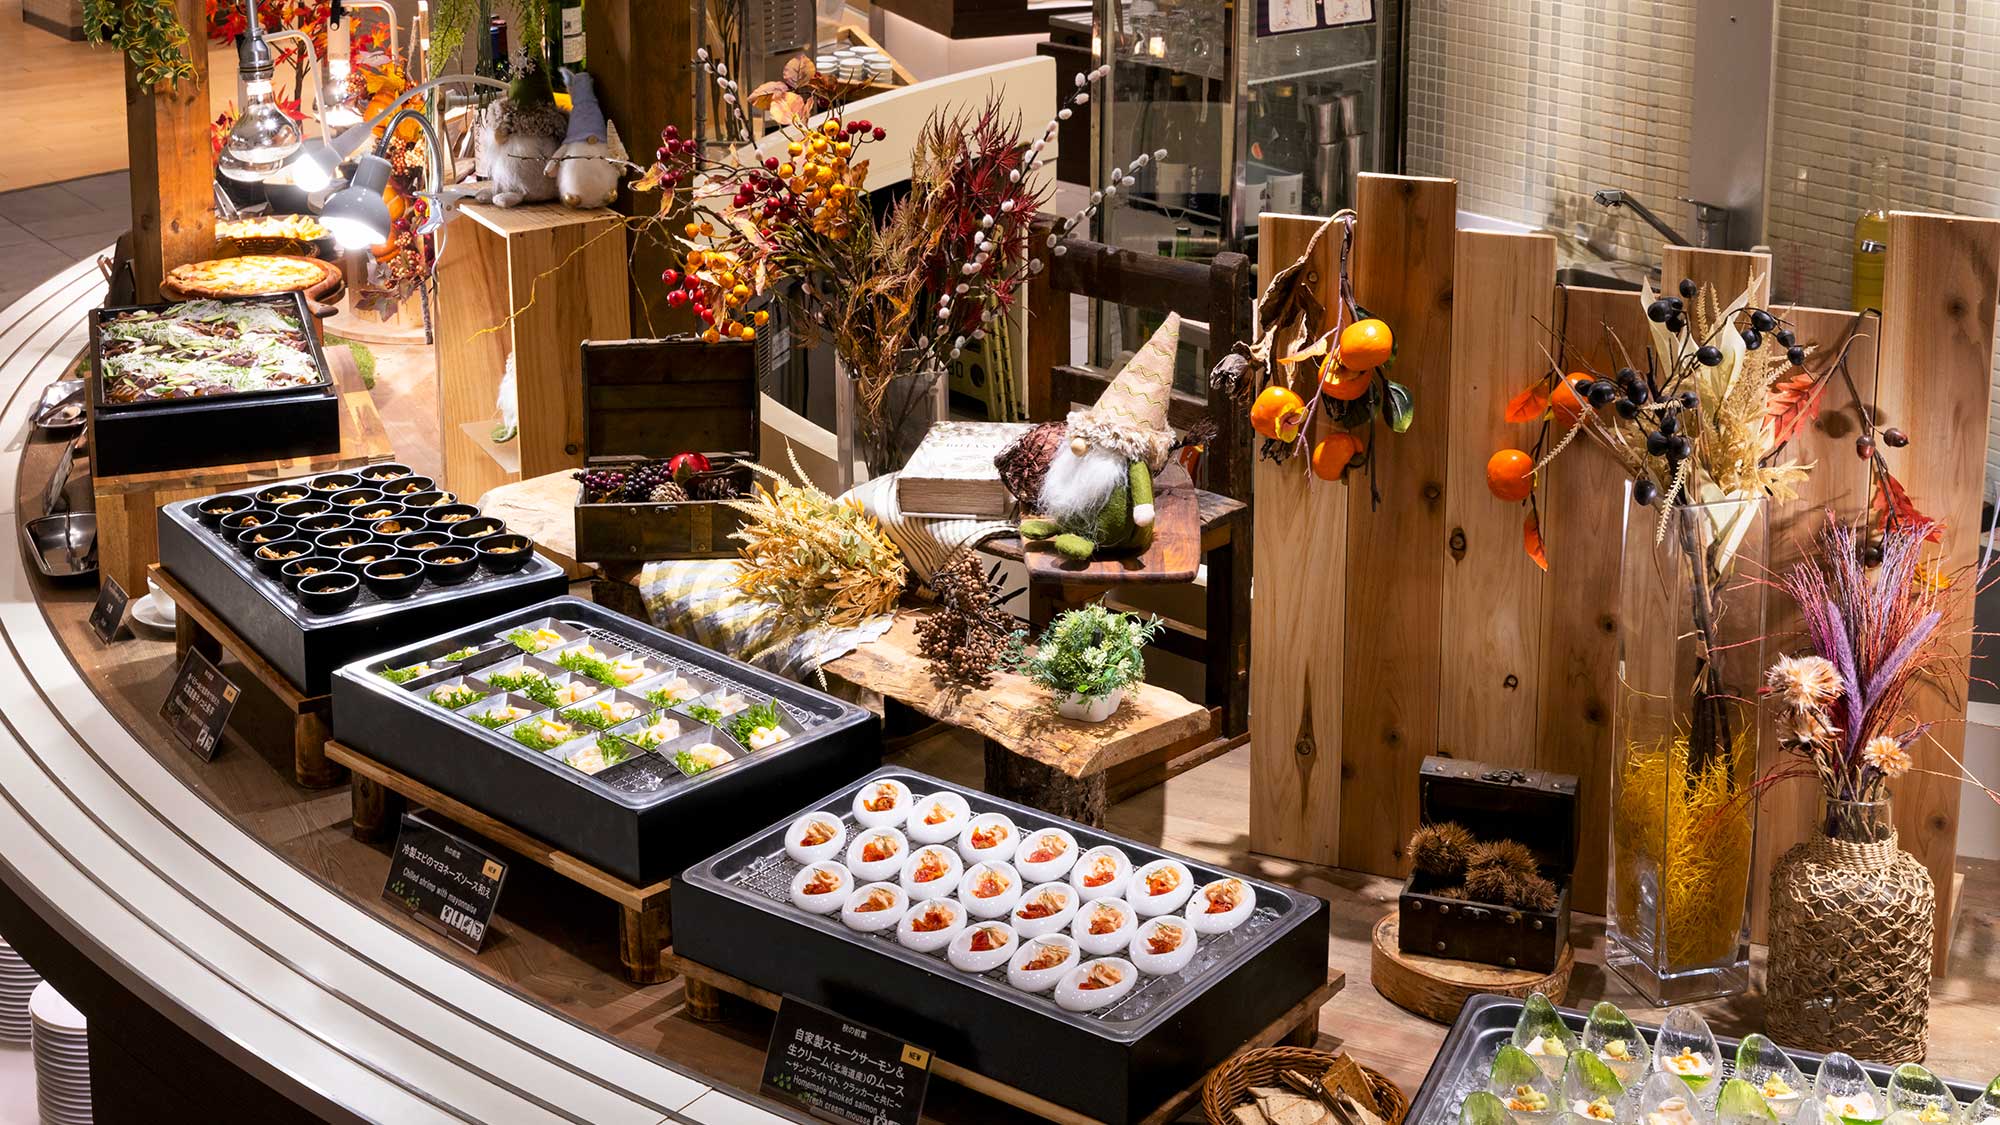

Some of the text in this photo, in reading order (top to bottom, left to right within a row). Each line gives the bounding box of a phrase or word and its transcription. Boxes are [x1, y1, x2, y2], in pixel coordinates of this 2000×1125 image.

[401, 843, 491, 900] 冷製エビのマヨネーズソース和え
[402, 867, 478, 915] Chilled shrimp with mayonnaise
[908, 1051, 922, 1063] NEW
[793, 1074, 828, 1096] Homemade
[828, 1089, 854, 1106] smoked
[854, 1100, 878, 1115] salmon
[824, 1102, 846, 1115] cream
[846, 1110, 871, 1125] mousse
